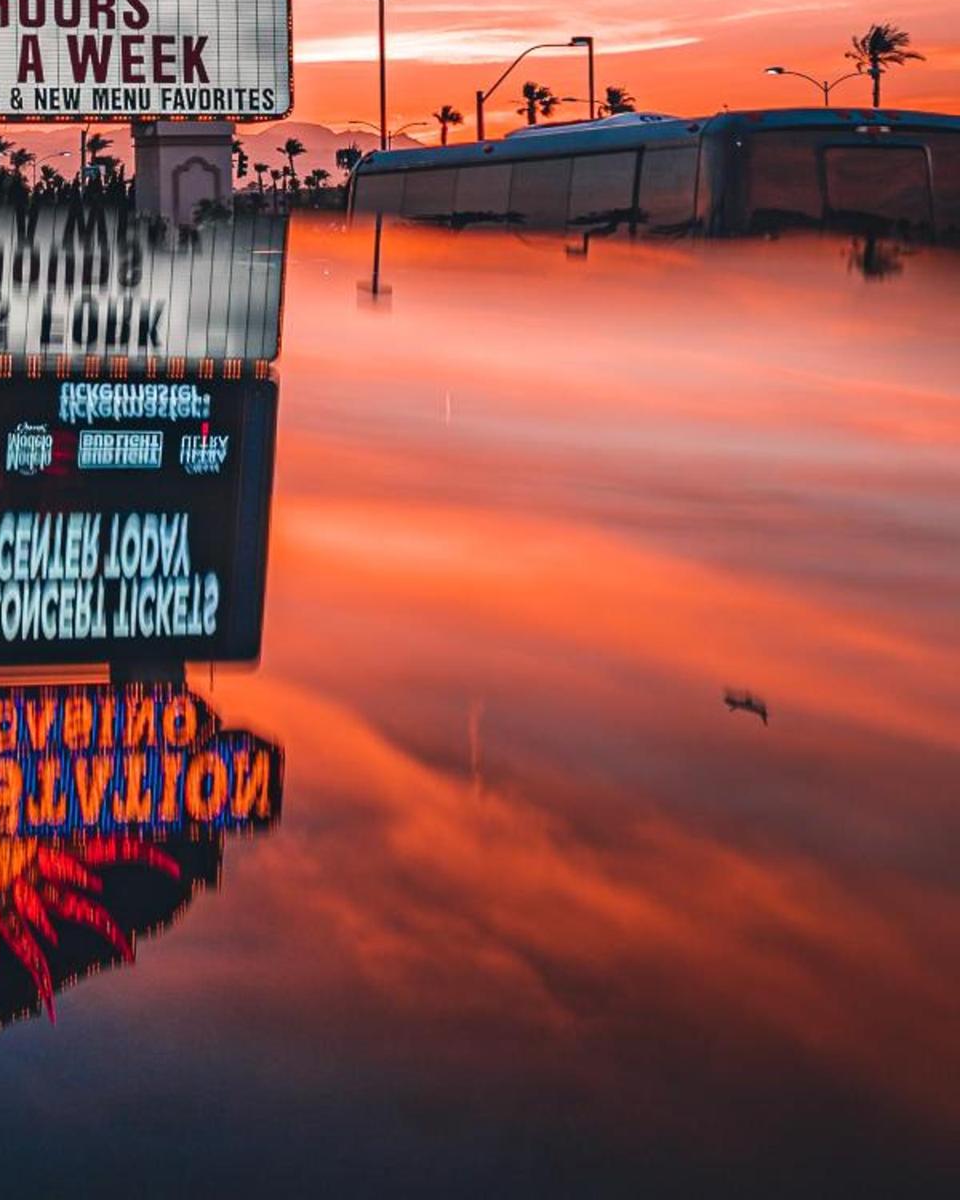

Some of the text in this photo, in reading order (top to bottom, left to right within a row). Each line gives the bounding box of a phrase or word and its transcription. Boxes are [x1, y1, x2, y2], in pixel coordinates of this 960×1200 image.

[17, 35, 46, 85] A
[69, 35, 211, 85] WEEK
[10, 87, 24, 111] &
[34, 87, 81, 111] NEW
[92, 87, 151, 112] MENU
[161, 87, 275, 112] FAVORITES
